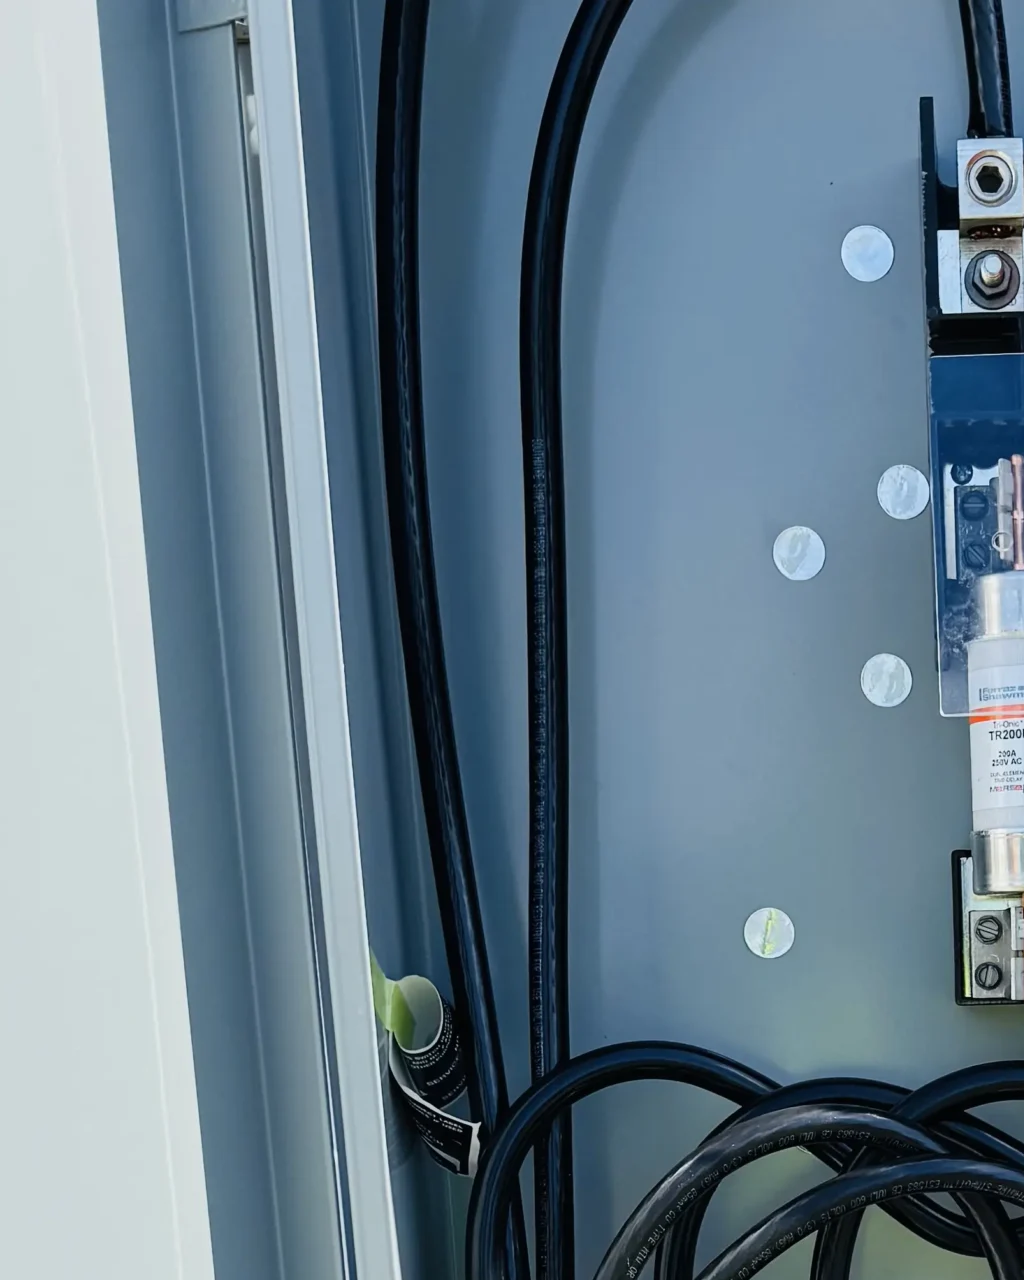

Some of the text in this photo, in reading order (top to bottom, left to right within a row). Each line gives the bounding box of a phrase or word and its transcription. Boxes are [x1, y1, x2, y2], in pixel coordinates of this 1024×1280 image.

[982, 686, 1016, 694] Ferraz
[998, 750, 1016, 758] 200A
[908, 1180, 940, 1192] E51583
[850, 1195, 866, 1208] 600
[820, 1204, 846, 1222] VOLTS
[648, 1224, 666, 1246] TYPE
[635, 1246, 650, 1264] MTW
[626, 1266, 638, 1278] OR
